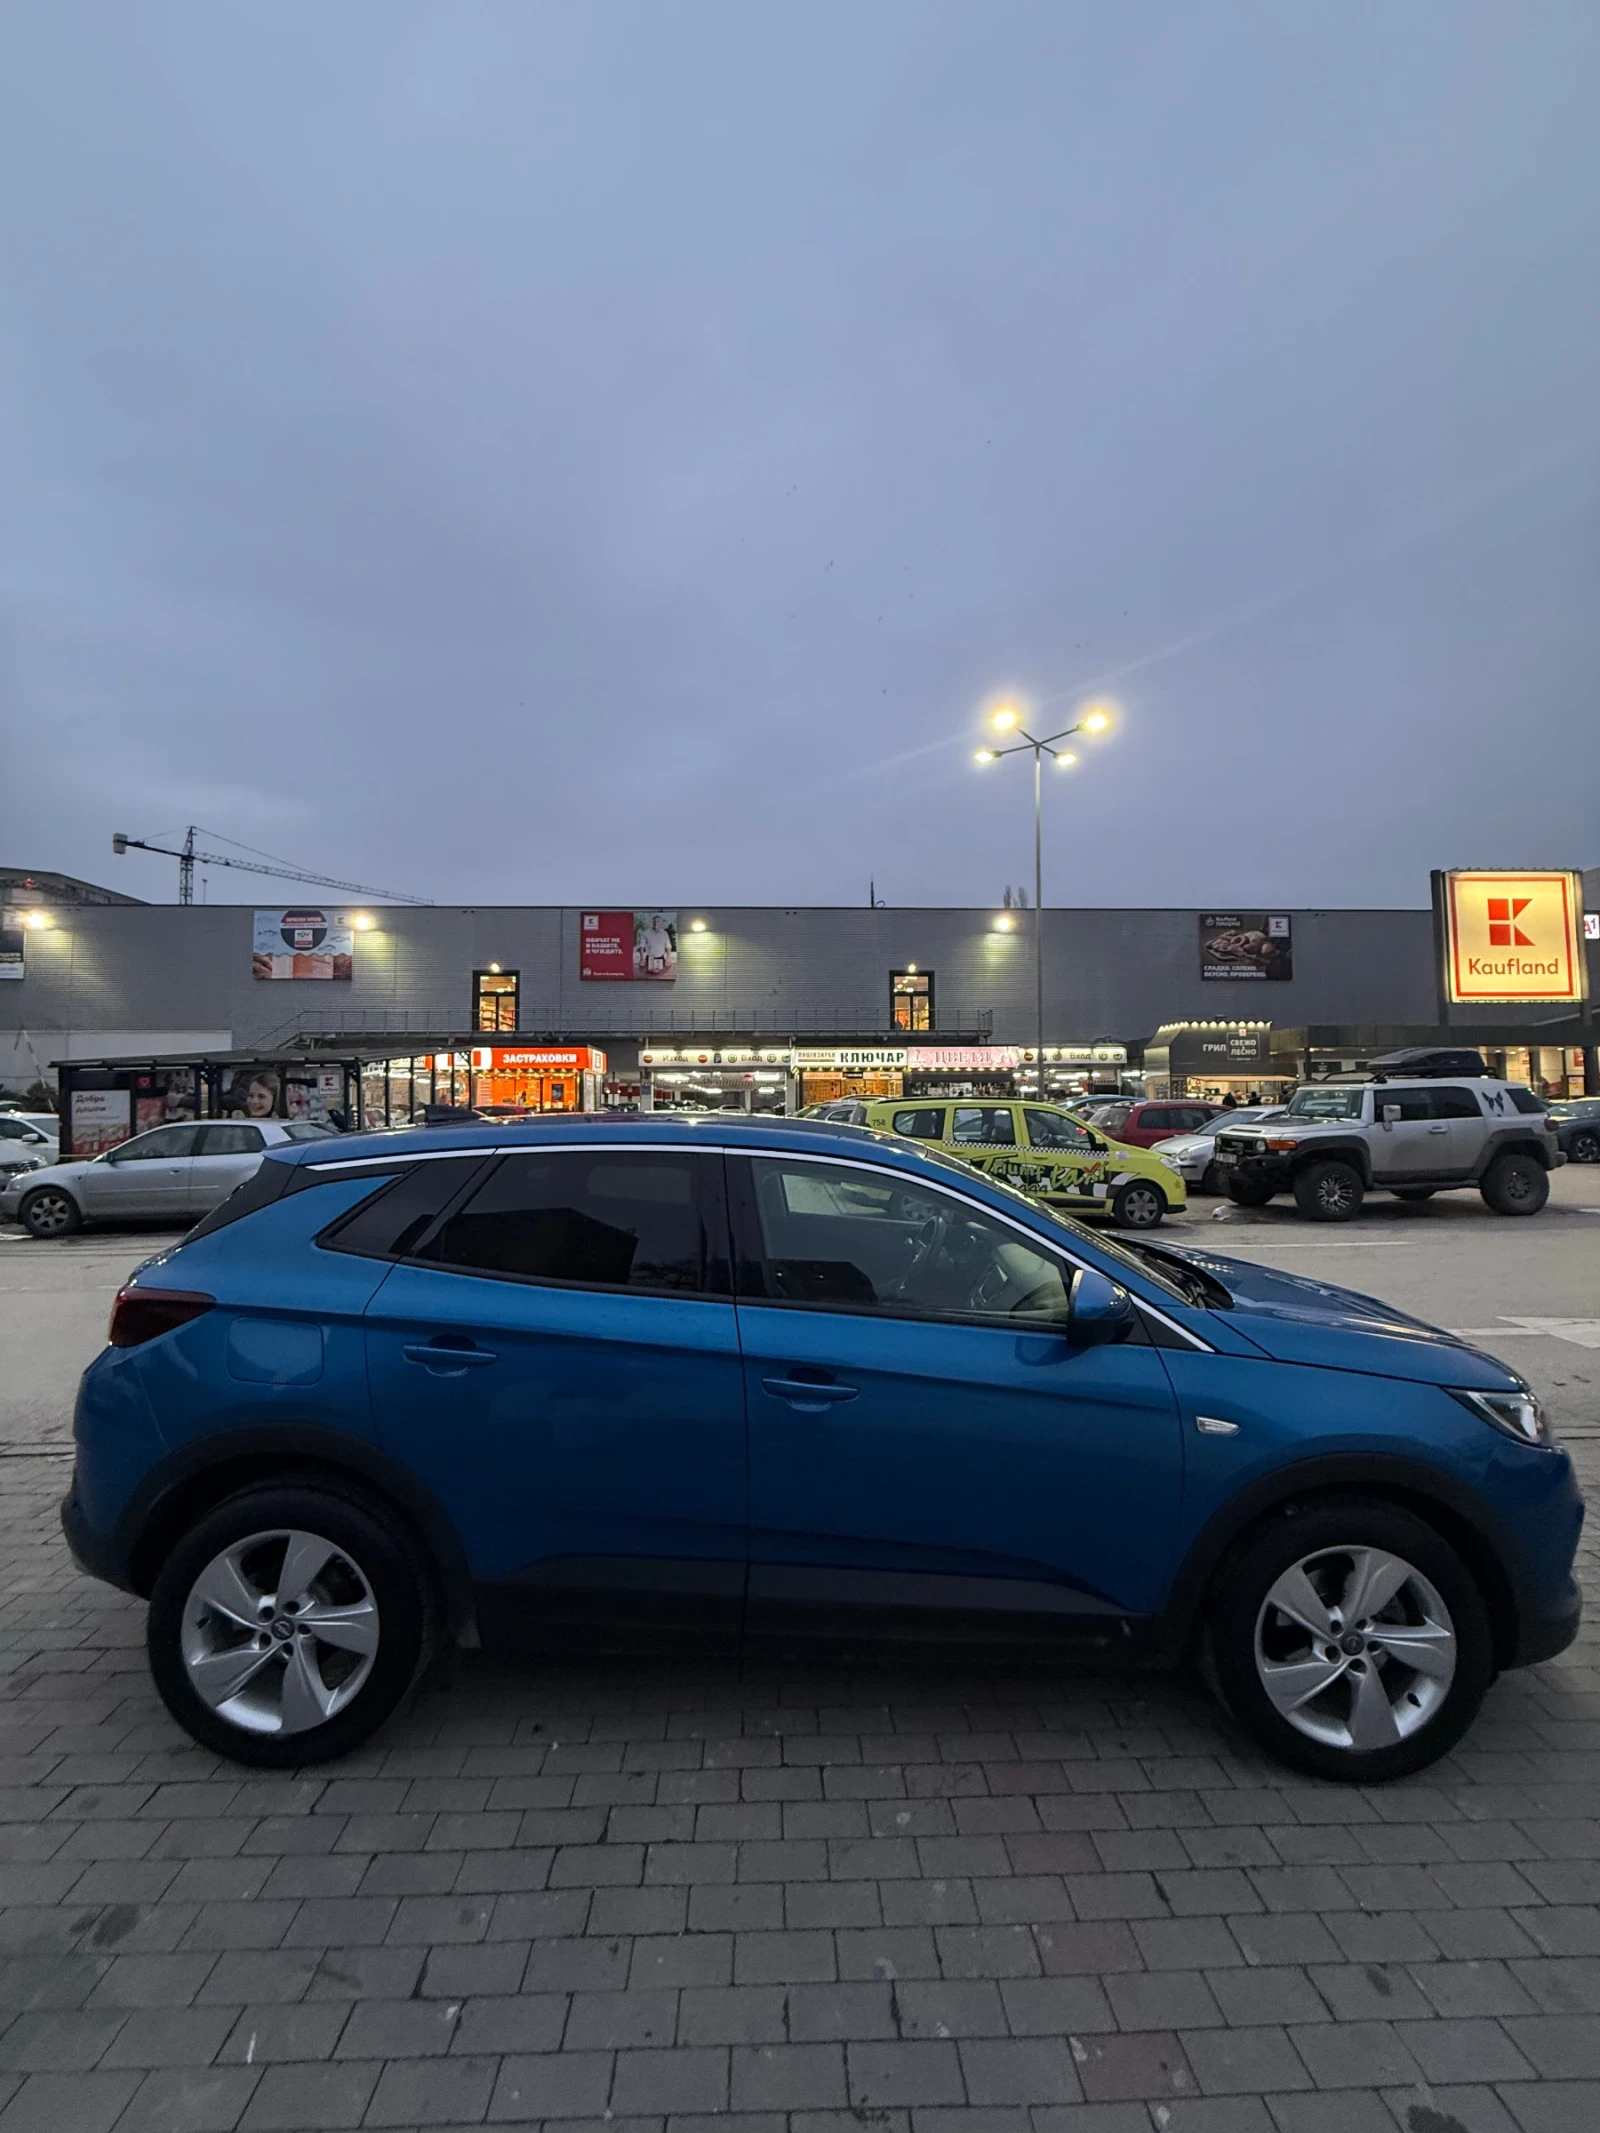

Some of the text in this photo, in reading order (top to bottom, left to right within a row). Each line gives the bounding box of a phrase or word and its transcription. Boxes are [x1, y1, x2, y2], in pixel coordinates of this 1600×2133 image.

[1468, 958, 1559, 975] Kaufland
[503, 1053, 577, 1063] ЗАСТРАХОВКИ
[662, 1054, 689, 1063] Изход
[741, 1054, 763, 1062] Вход
[840, 1052, 904, 1063] КЛЮЧАР
[935, 1051, 992, 1064] ЦВЕТЯ
[1070, 1052, 1092, 1060] Вход
[75, 1094, 106, 1104] Добре
[872, 1118, 886, 1126] 758
[970, 1151, 1045, 1181] Triumf
